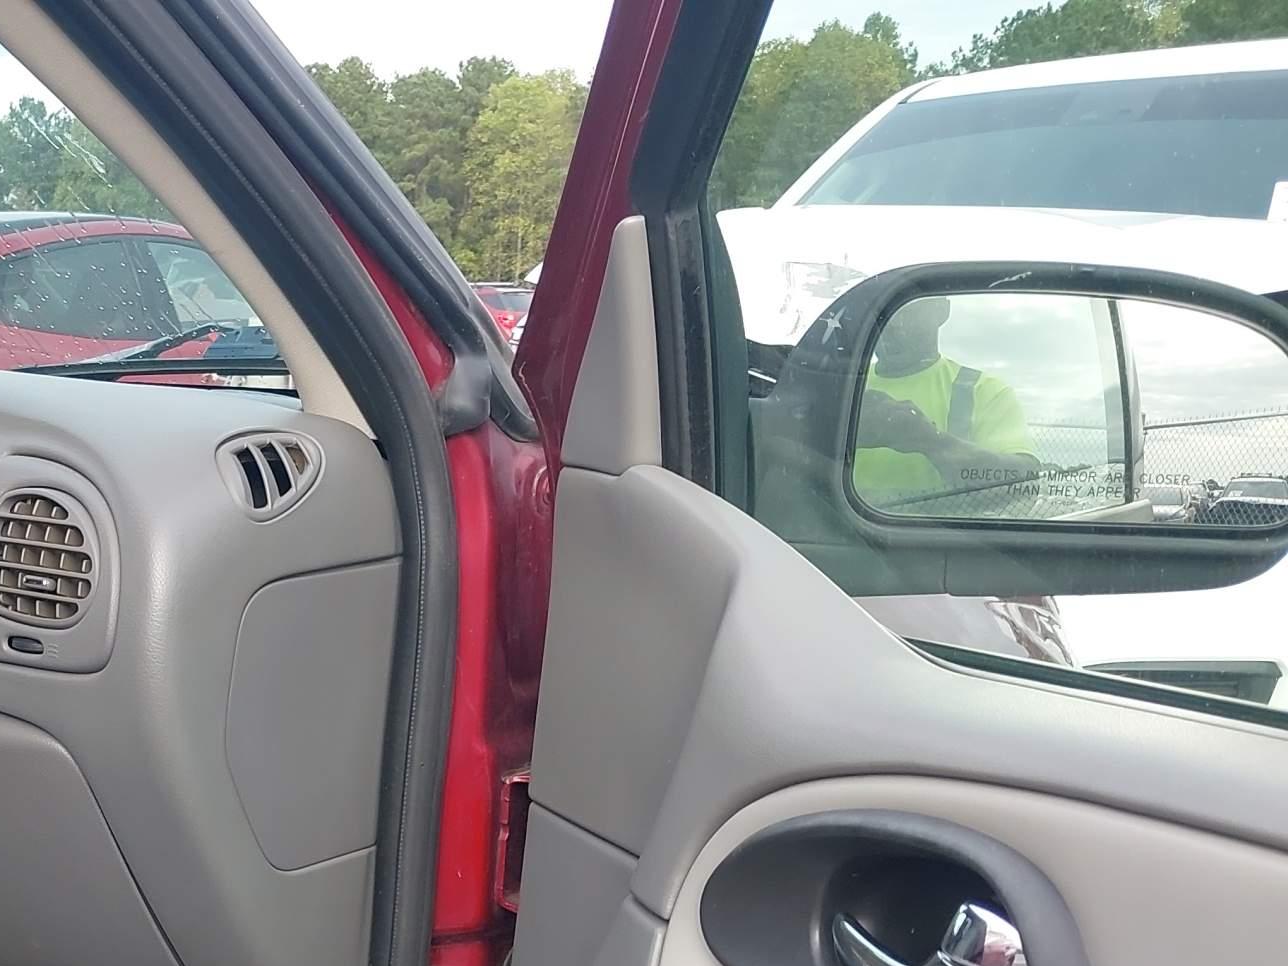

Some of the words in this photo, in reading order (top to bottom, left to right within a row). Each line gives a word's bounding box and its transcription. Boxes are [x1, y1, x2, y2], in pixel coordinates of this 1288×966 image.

[960, 468, 1018, 481] OBJECTS
[1046, 470, 1097, 483] MIRROR
[1139, 473, 1190, 485] CLOSER
[1006, 485, 1041, 497] THAN
[1047, 485, 1082, 497] THEY
[1086, 486, 1141, 499] APPER
